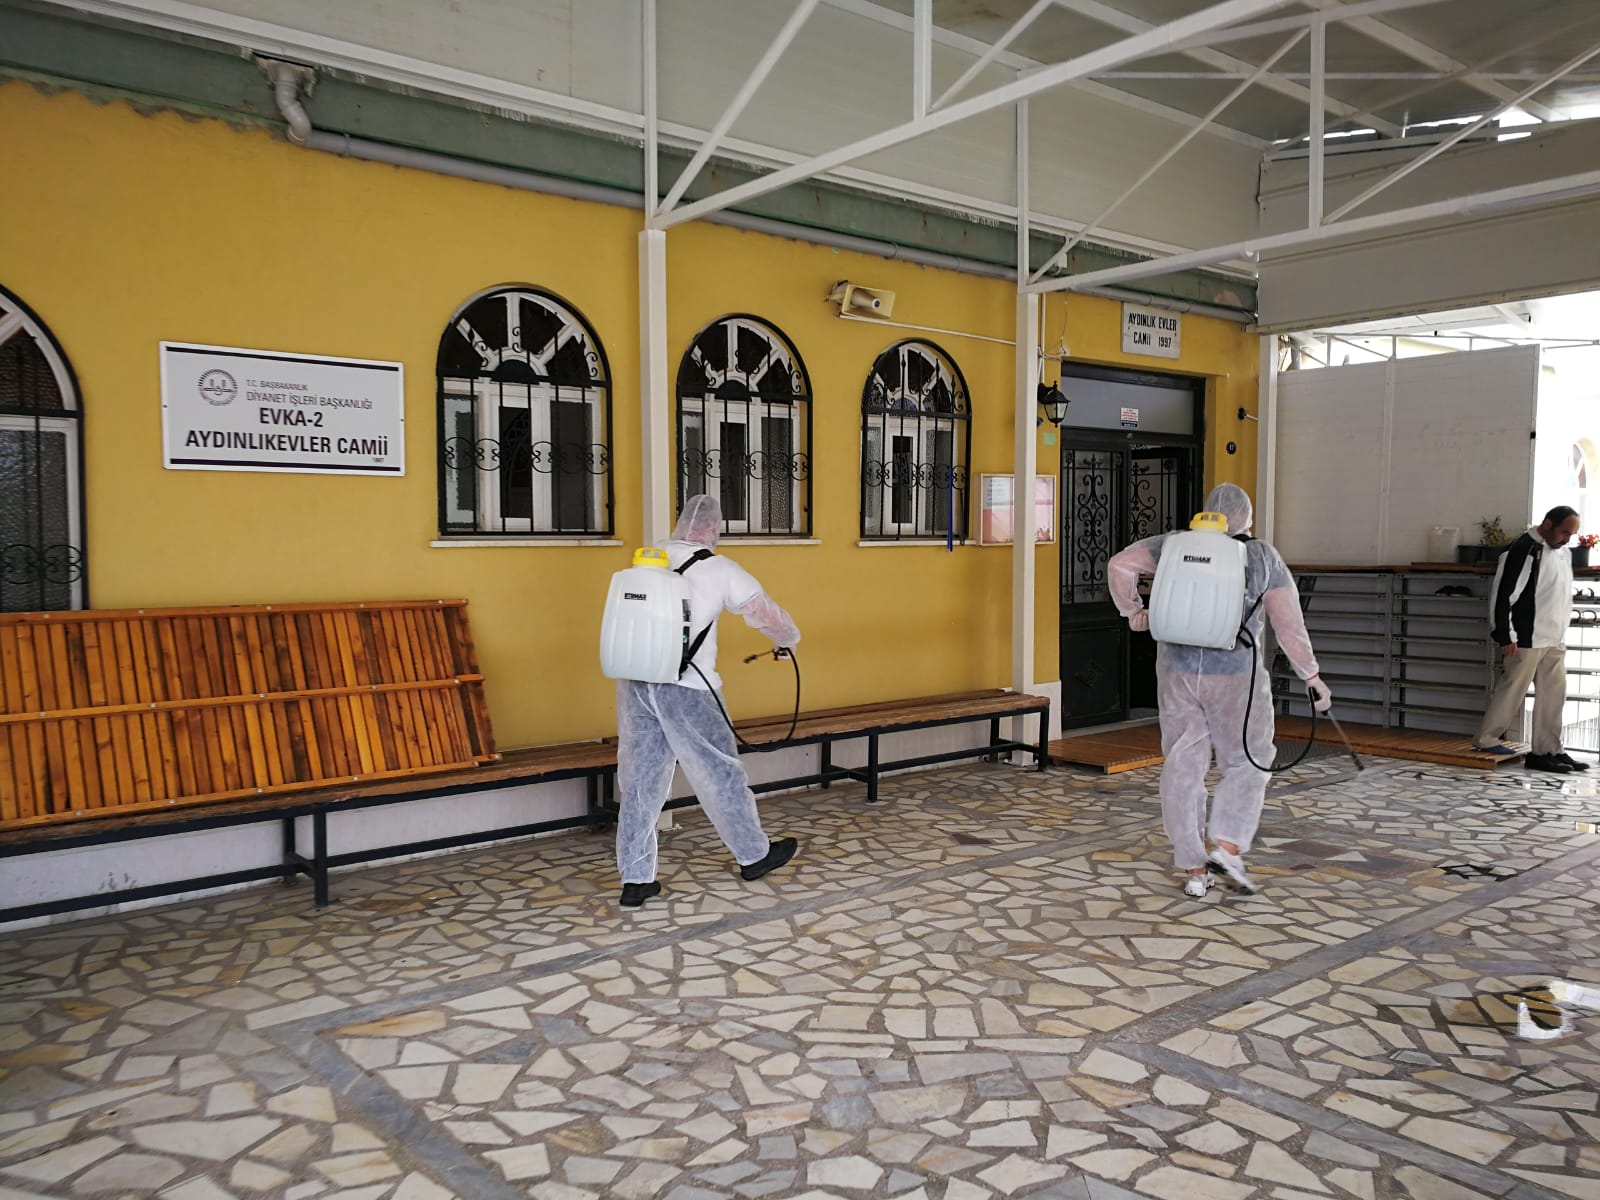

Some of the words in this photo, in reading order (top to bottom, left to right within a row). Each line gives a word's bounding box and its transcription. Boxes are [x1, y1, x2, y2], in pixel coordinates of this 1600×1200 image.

[1128, 312, 1156, 328] AYDINLIK
[1158, 316, 1177, 331] EVLER
[1158, 335, 1172, 348] 1997
[246, 389, 287, 403] DİYANET
[289, 392, 318, 406] İŞLERİ
[320, 396, 373, 410] BAŞKANLIĞI
[259, 407, 323, 427] EVKA-2
[186, 430, 331, 453] AYDINLIKEVLER
